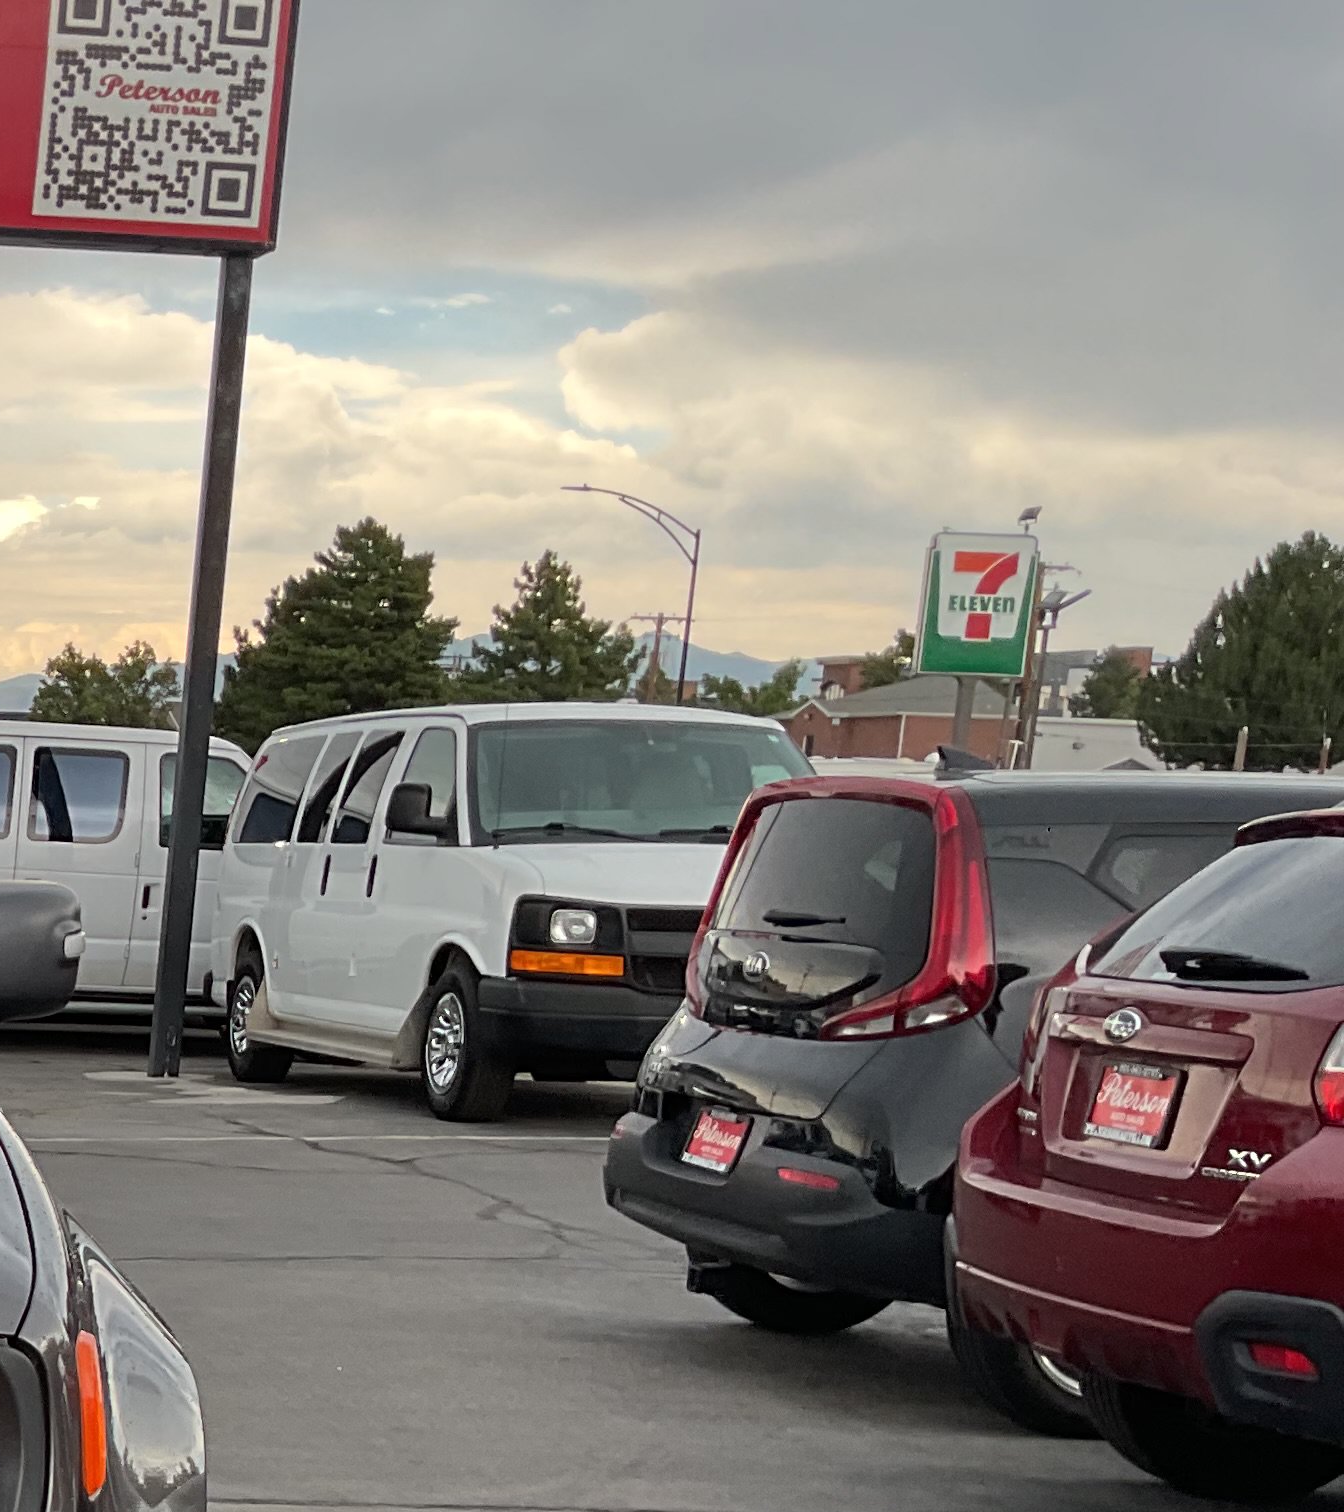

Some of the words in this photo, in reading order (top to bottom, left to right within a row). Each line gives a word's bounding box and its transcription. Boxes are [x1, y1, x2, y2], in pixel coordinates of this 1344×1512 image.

[95, 74, 221, 104] Peterson
[149, 104, 179, 114] AUTO
[1097, 1073, 1172, 1115] Peterson
[1227, 1149, 1272, 1168] XV
